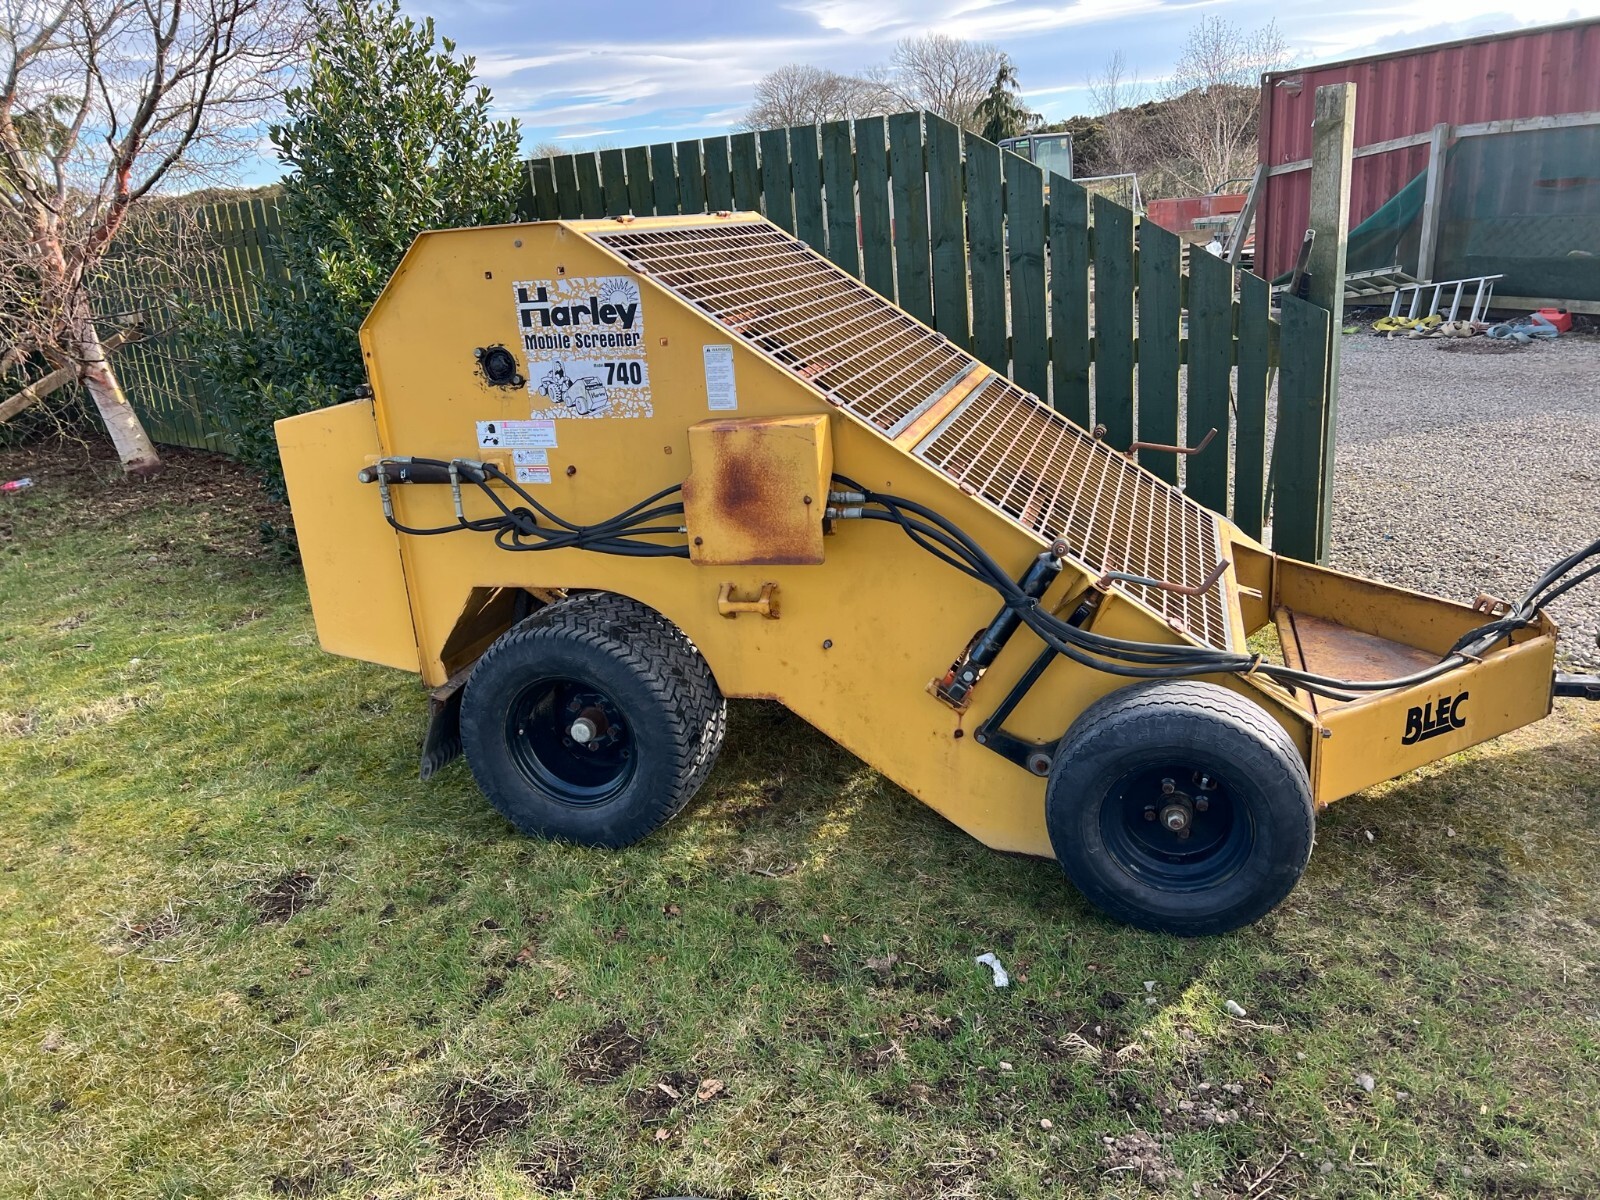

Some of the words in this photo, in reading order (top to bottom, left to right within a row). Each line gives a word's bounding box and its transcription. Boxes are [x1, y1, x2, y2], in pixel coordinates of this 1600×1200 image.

[517, 286, 637, 329] Harley
[524, 334, 571, 349] Mobile
[575, 332, 640, 348] Screener
[604, 361, 642, 385] 740
[1401, 691, 1469, 745] BLEC
